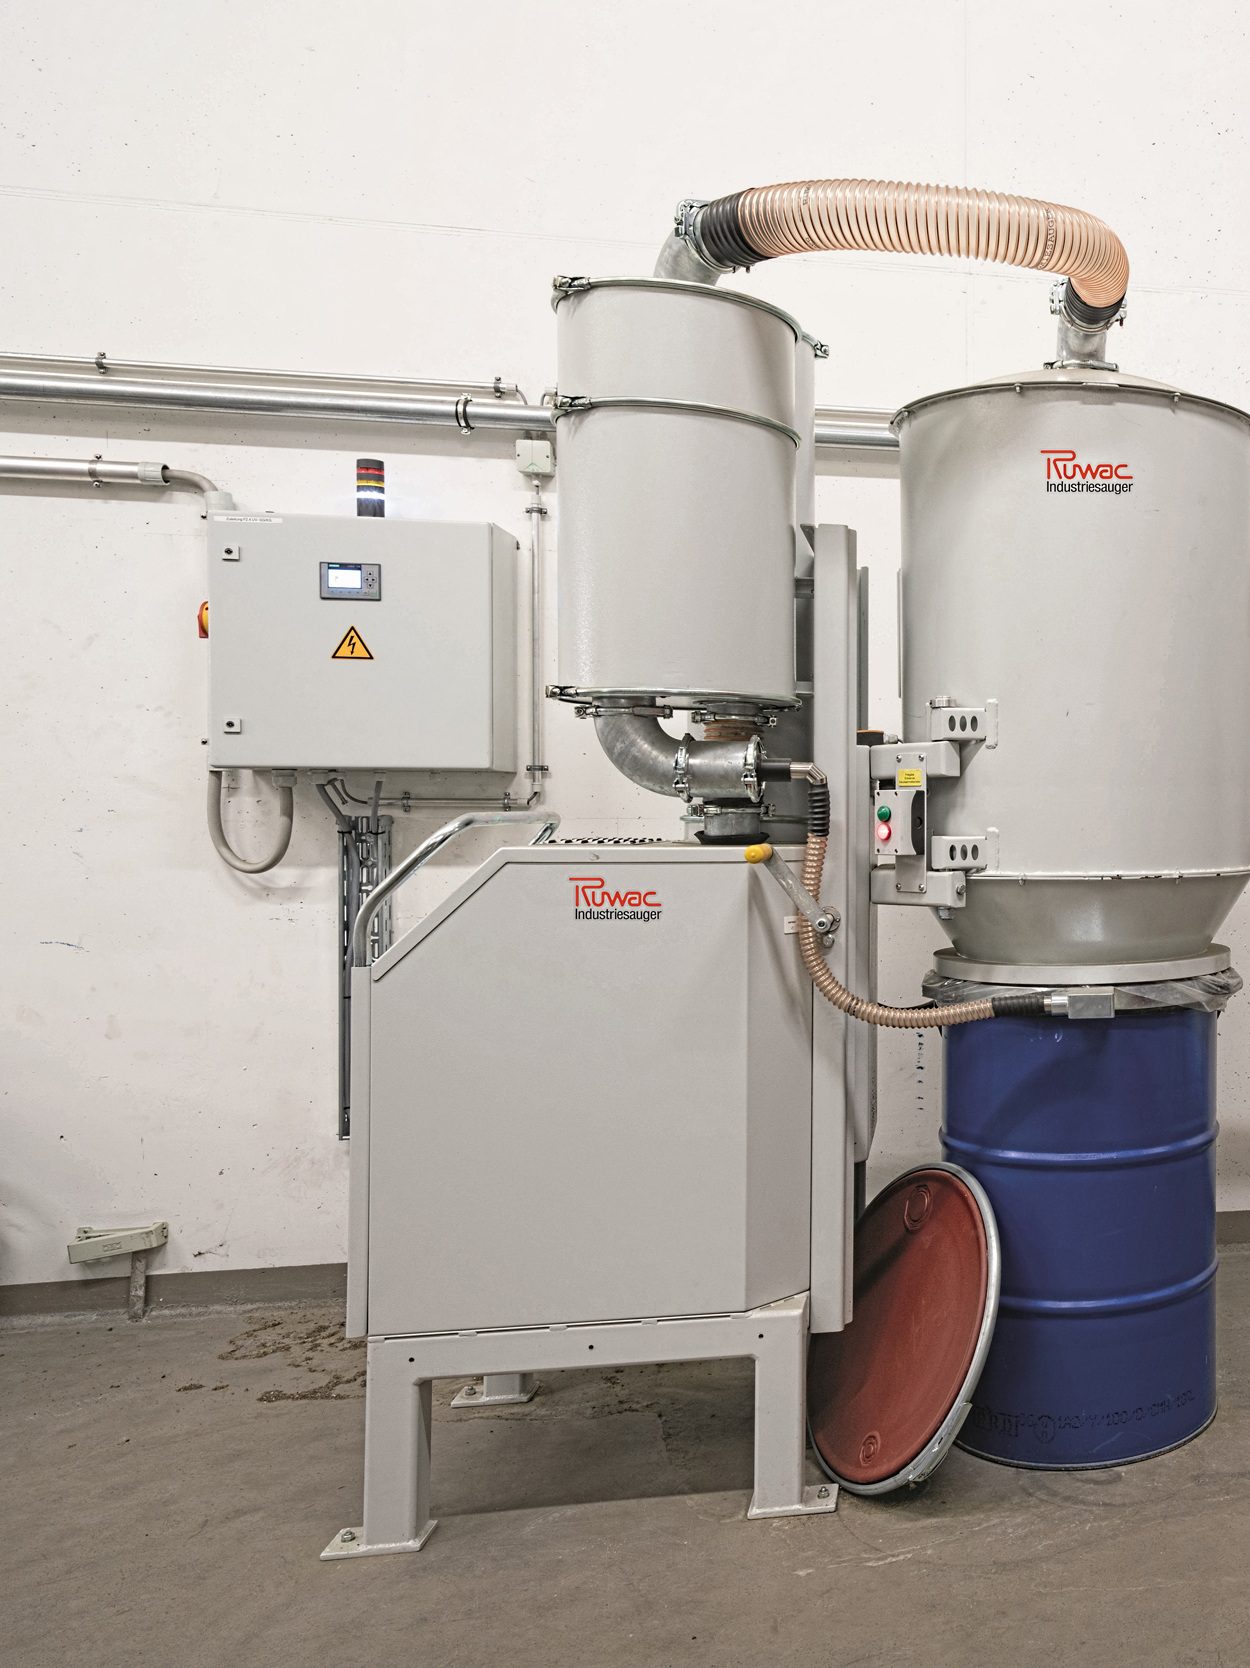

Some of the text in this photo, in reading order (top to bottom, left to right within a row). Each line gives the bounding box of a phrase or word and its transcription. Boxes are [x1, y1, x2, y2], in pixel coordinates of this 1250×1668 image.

[1040, 449, 1133, 480] Ruwac
[1046, 481, 1133, 495] Industriesauger
[569, 877, 662, 907] Ruwac
[575, 908, 662, 923] Industriesauger
